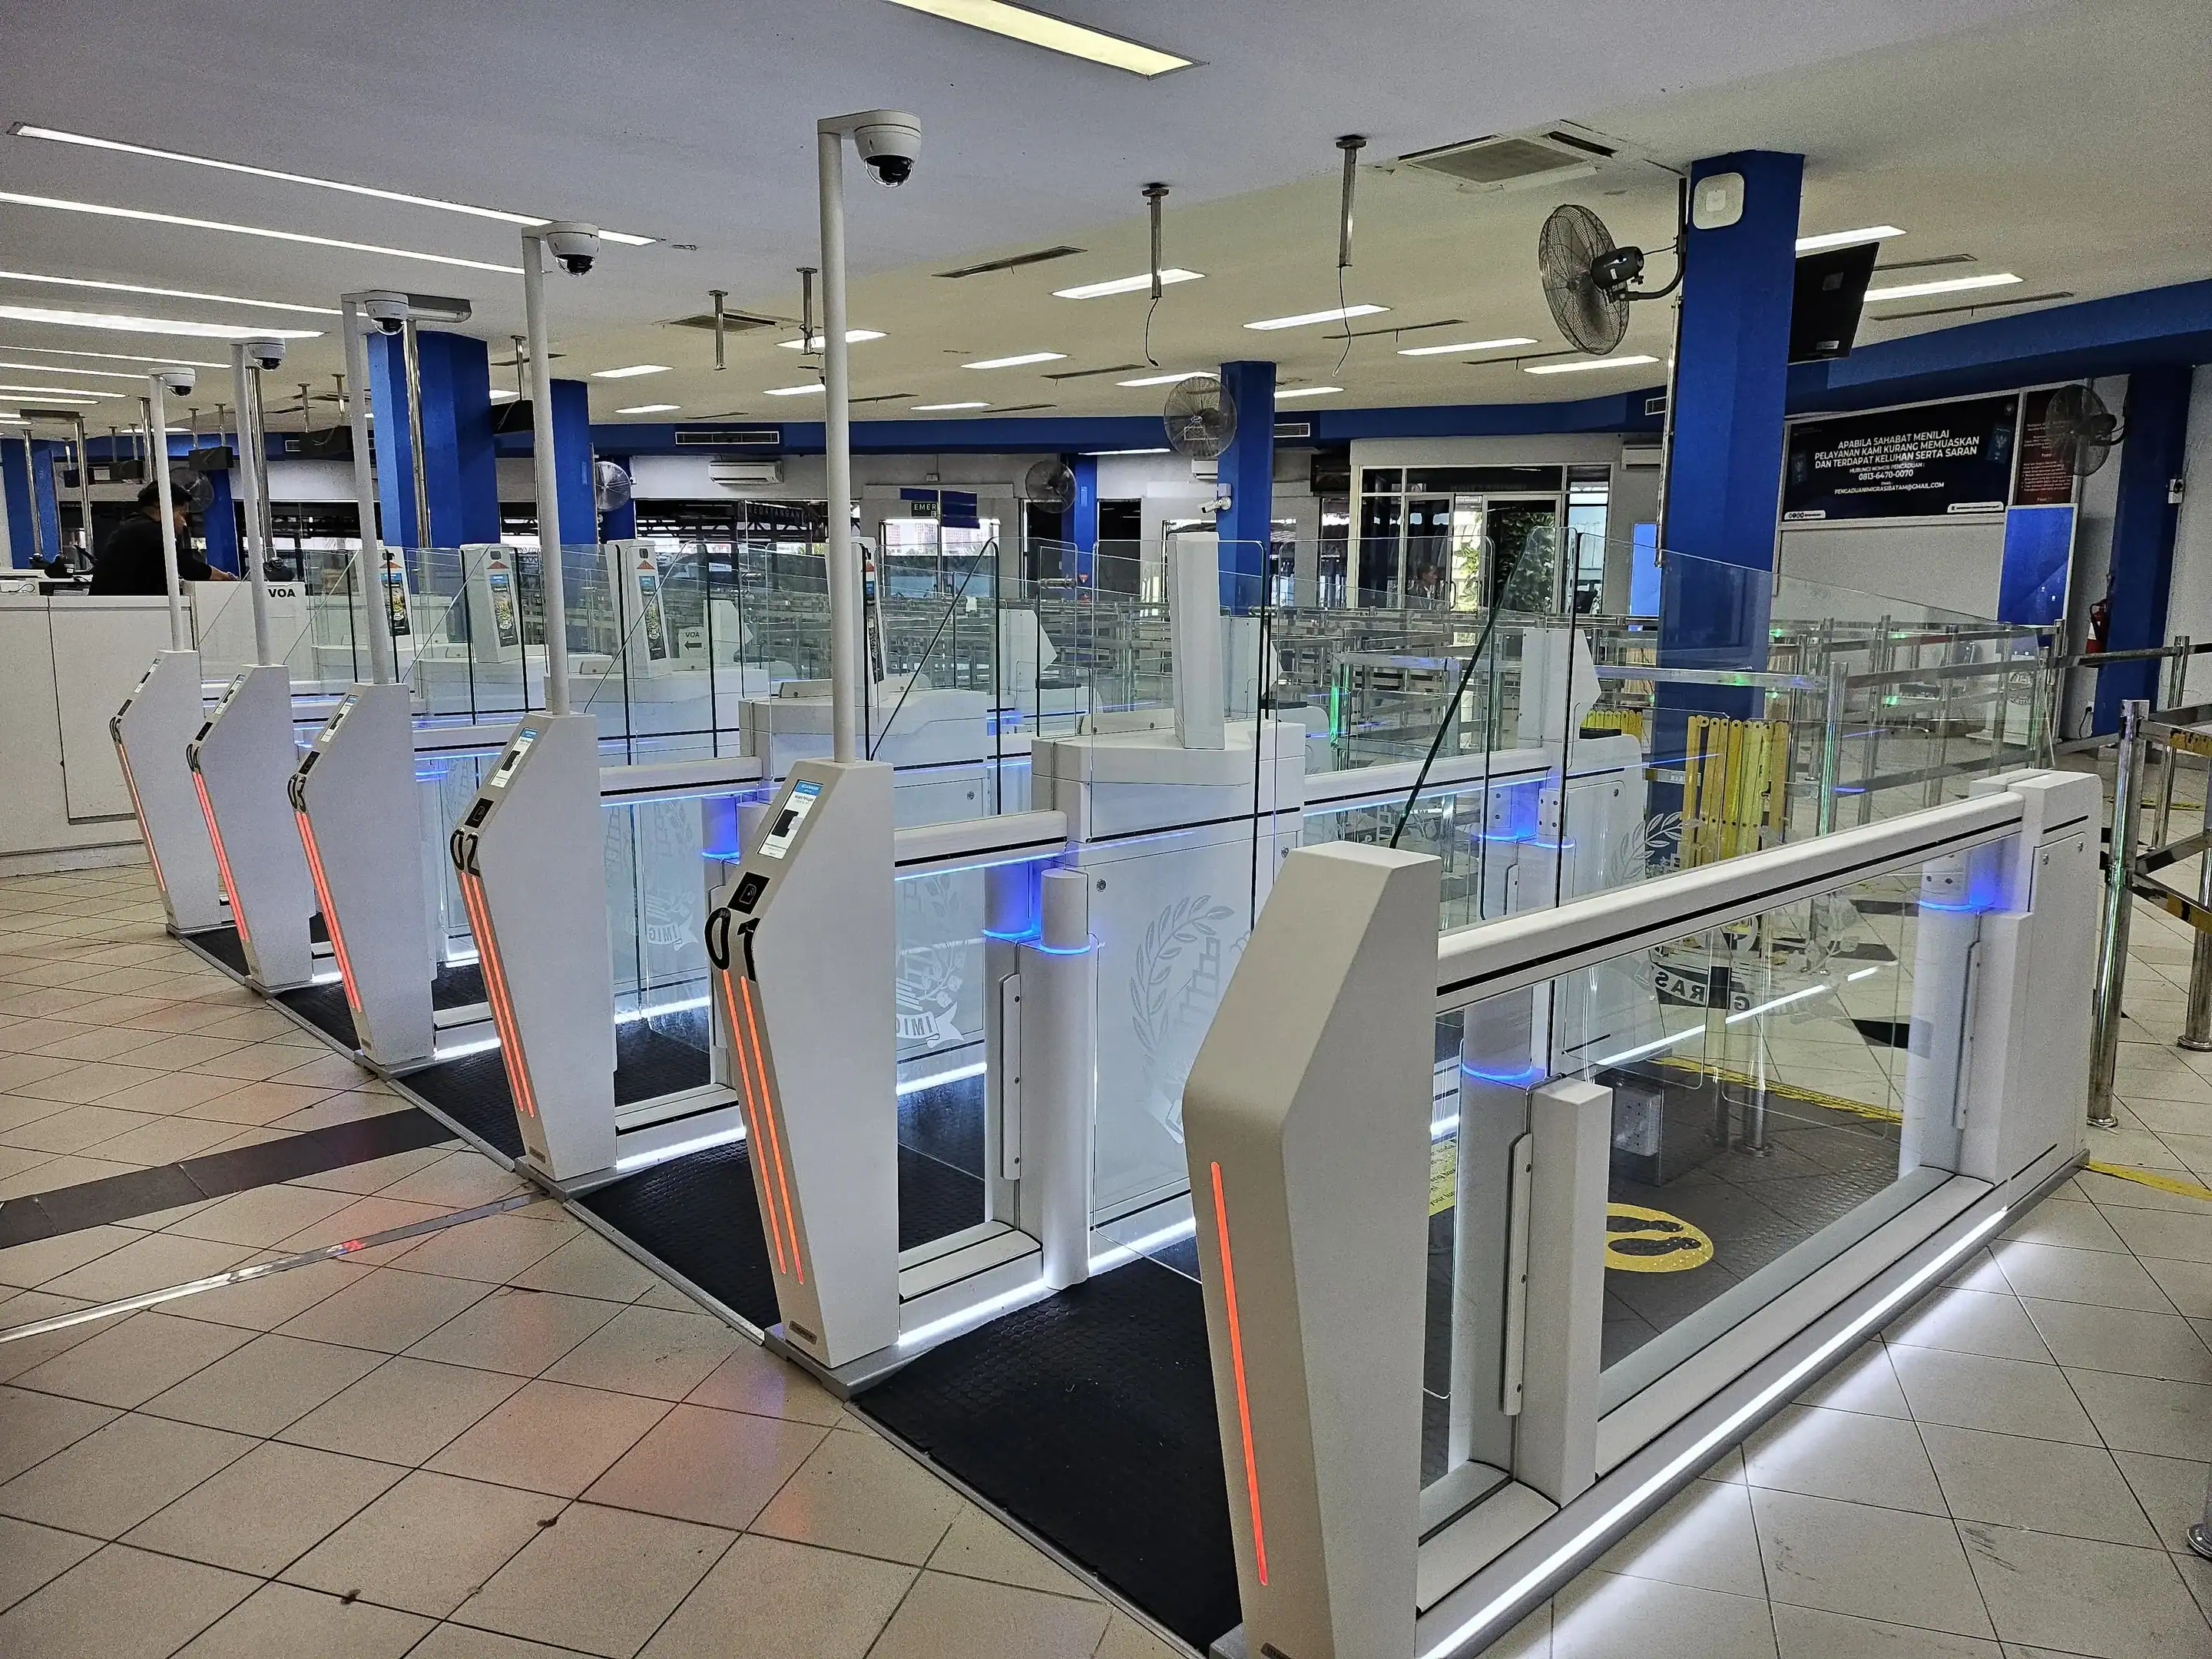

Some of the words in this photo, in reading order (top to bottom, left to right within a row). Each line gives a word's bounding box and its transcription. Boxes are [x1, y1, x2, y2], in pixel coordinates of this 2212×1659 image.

[1814, 448, 1859, 461] PELAYANAN
[1861, 445, 1883, 456] KAMI
[1883, 442, 1919, 454] KURANG
[1920, 435, 1980, 450] MEMUASKAN
[1838, 438, 1872, 450] APABILA
[1873, 433, 1912, 445] SAHABAT
[1913, 429, 1949, 442] MENILAI
[1815, 460, 1832, 469] DAN
[1833, 455, 1874, 468] TERDAPAT
[1875, 452, 1914, 463] KELUHAN
[1915, 449, 1943, 460] SERTA
[1945, 445, 1978, 458] SARAN
[1858, 469, 1914, 481] 0813-6470-0070
[267, 588, 296, 598] VOA
[287, 773, 306, 813] 03
[449, 828, 480, 878] 02
[704, 906, 761, 982] 01
